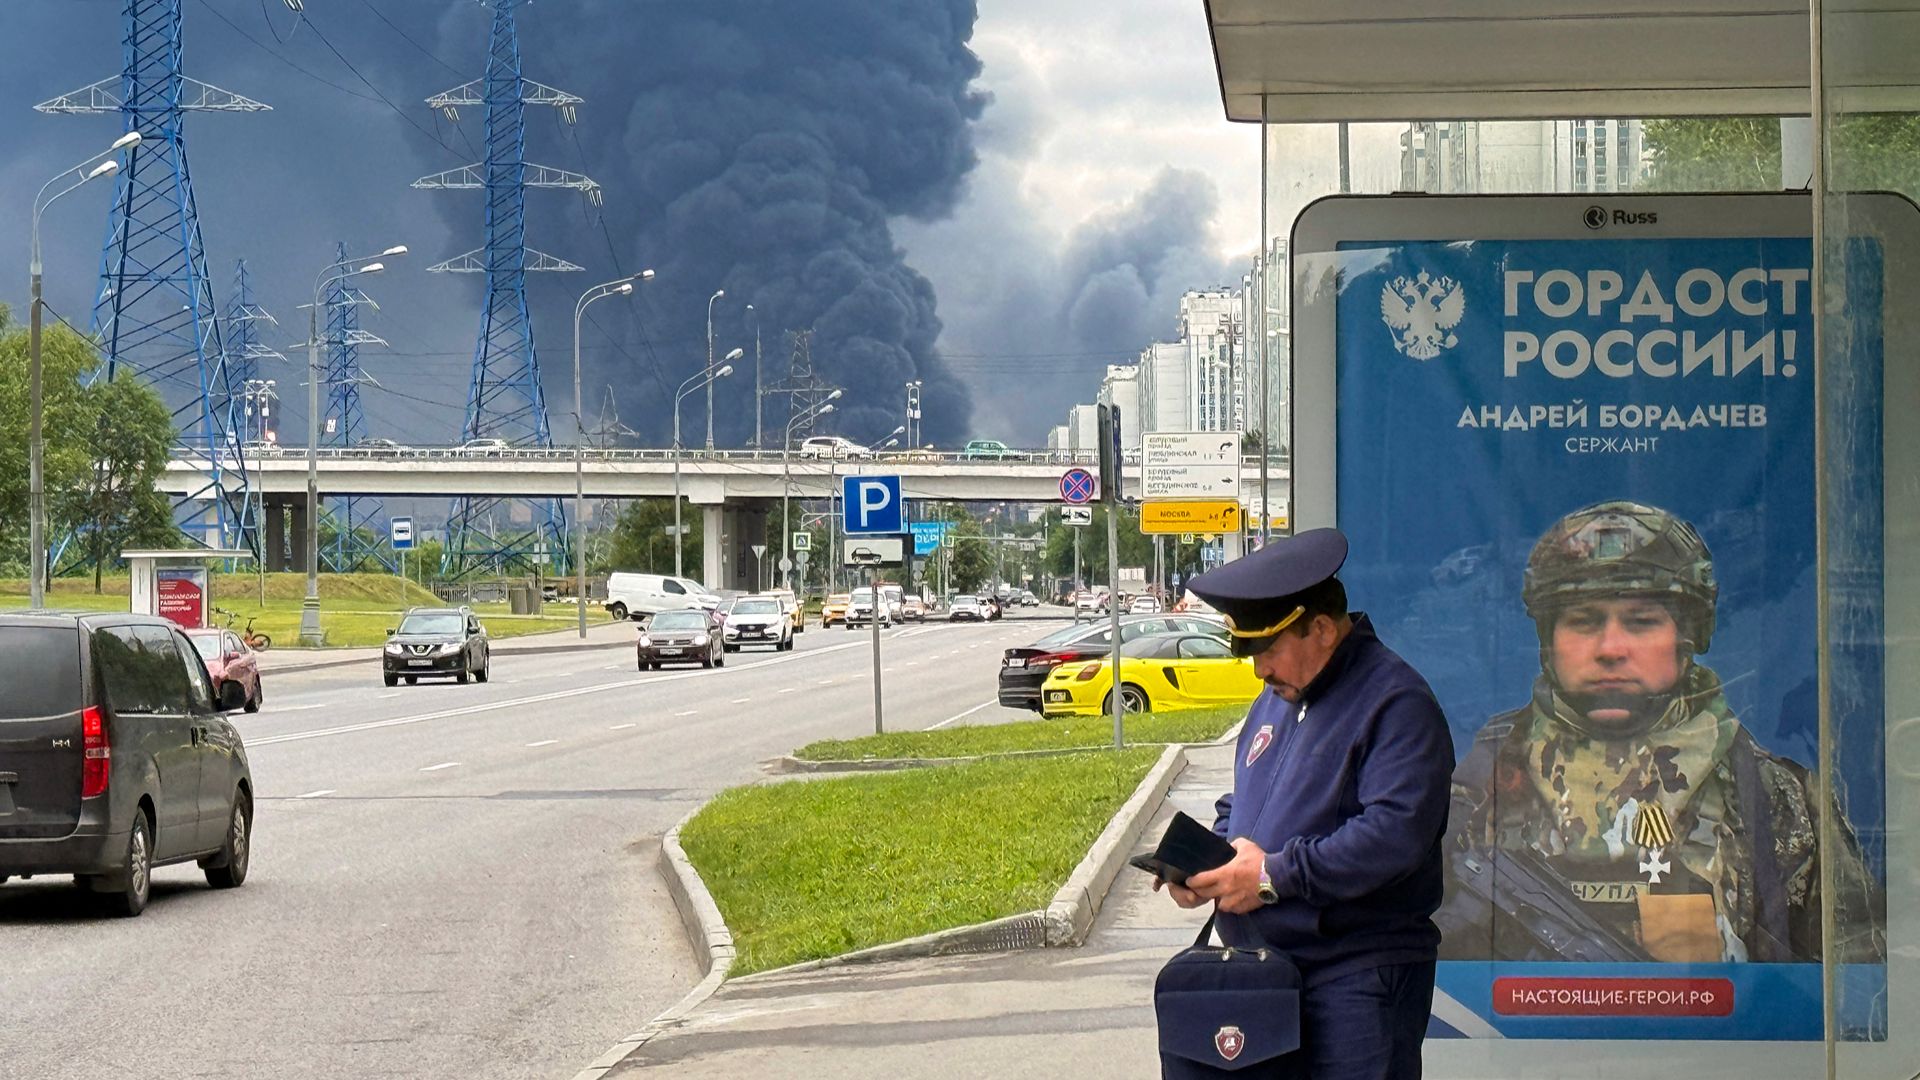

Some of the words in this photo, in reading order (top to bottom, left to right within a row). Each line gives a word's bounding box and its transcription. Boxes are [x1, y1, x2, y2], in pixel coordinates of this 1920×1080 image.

[1612, 209, 1658, 225] Russ
[1503, 328, 1798, 379] РОССИИ!
[1456, 398, 1588, 431] АНДРЕЙ
[1599, 404, 1768, 431] БОРДАЧЕВ
[1564, 436, 1659, 454] СЕРЖАНТ
[859, 481, 891, 528] P
[1511, 988, 1715, 1006] НАСТОЯЩИЕ-ГЕРОИ.РФ
